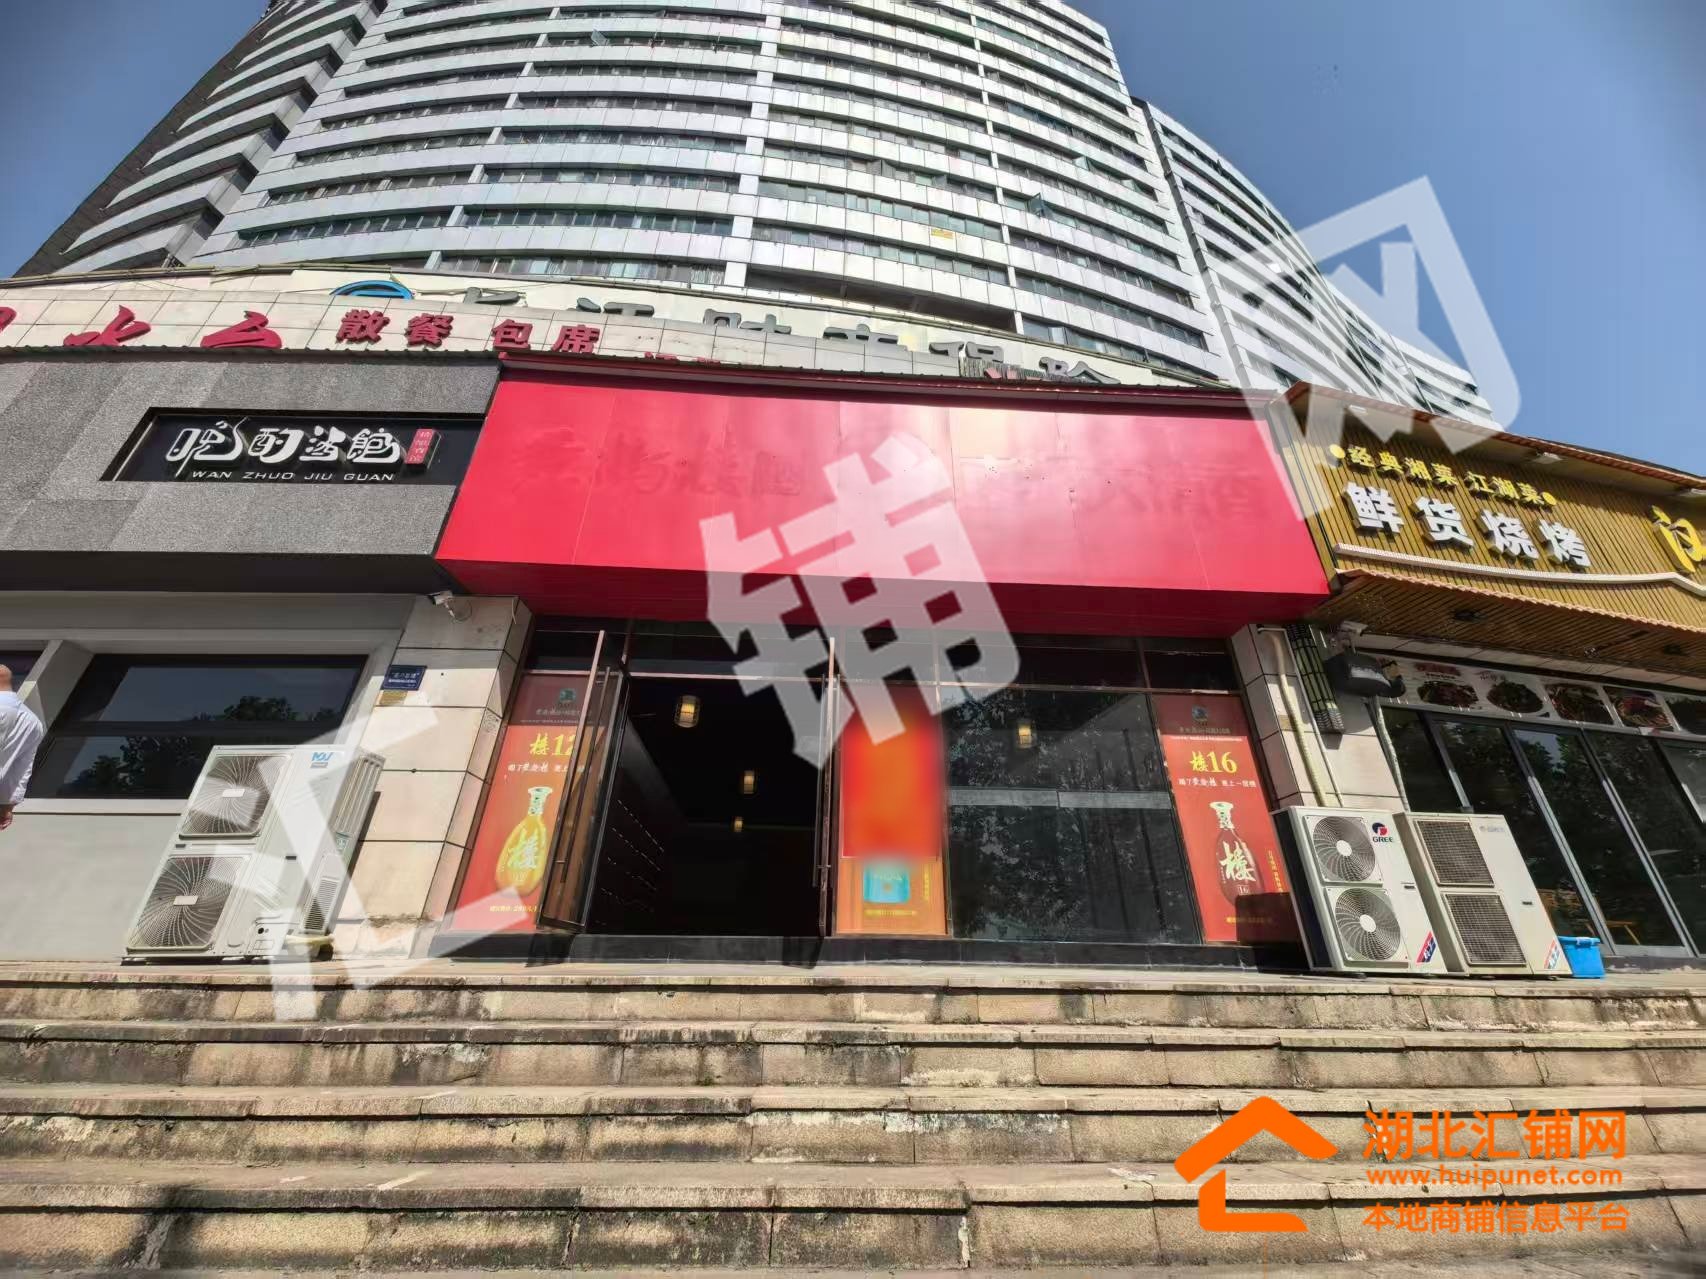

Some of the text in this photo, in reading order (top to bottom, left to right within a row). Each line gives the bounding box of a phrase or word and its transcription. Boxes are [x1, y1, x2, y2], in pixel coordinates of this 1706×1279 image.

[191, 471, 394, 482] WAN ZHUO JIU GUAN
[1344, 481, 1592, 568] 鲜货烧烤
[1189, 750, 1238, 774] 楼16
